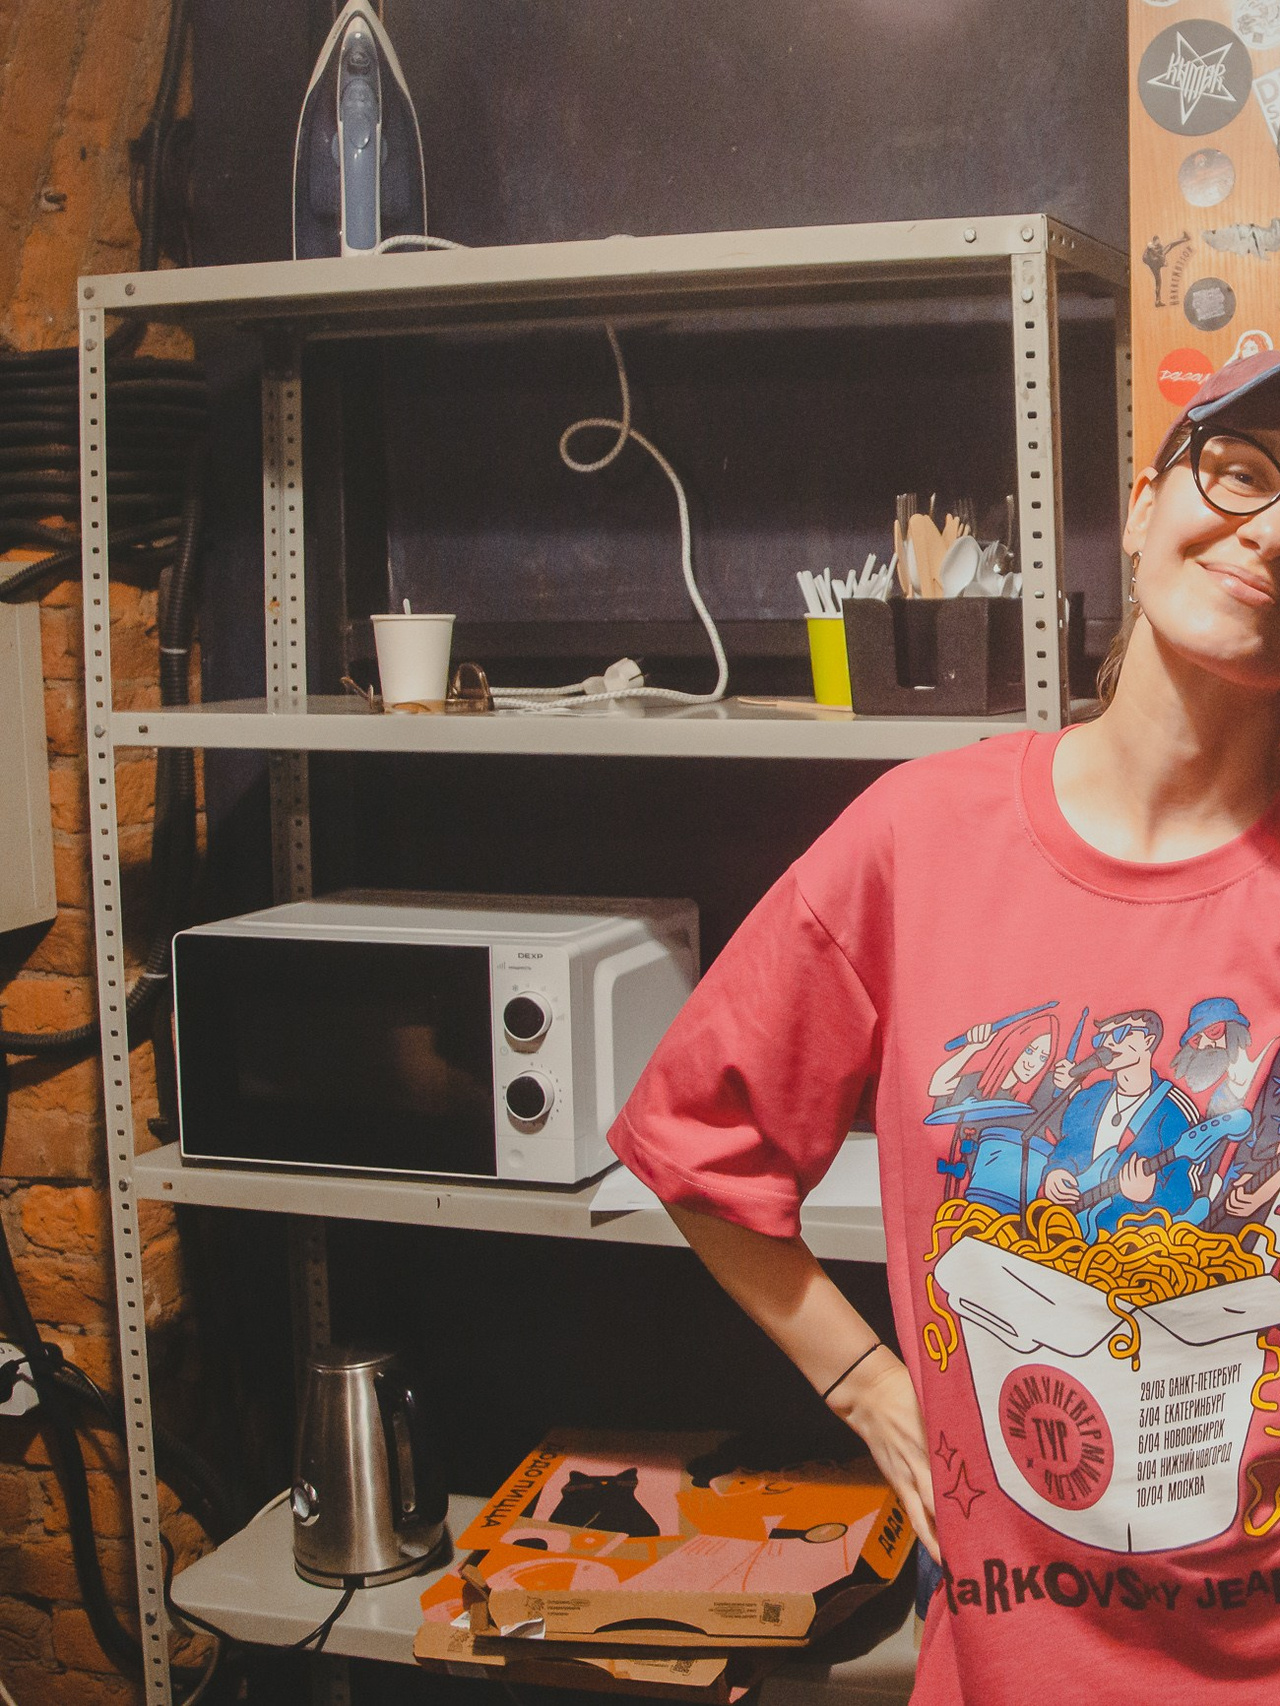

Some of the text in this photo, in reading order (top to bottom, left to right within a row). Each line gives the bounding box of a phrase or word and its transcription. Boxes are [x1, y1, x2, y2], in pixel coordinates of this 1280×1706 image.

[1140, 1363, 1242, 1401] 29/03 САНКТ-ПЕТЕРБУРГ
[1139, 1392, 1226, 1428] 3/04 ЕКАТЕРИНБУРГ
[1032, 1416, 1068, 1462] ТУР
[1138, 1418, 1226, 1454] 6/04 НОВОСИБИРСК
[1137, 1442, 1233, 1481] 9/04 НИЖНИЙ НОВГОРОД
[480, 1480, 535, 1528] ПИЦЦА
[1137, 1475, 1205, 1508] 10/04 МОСКВА
